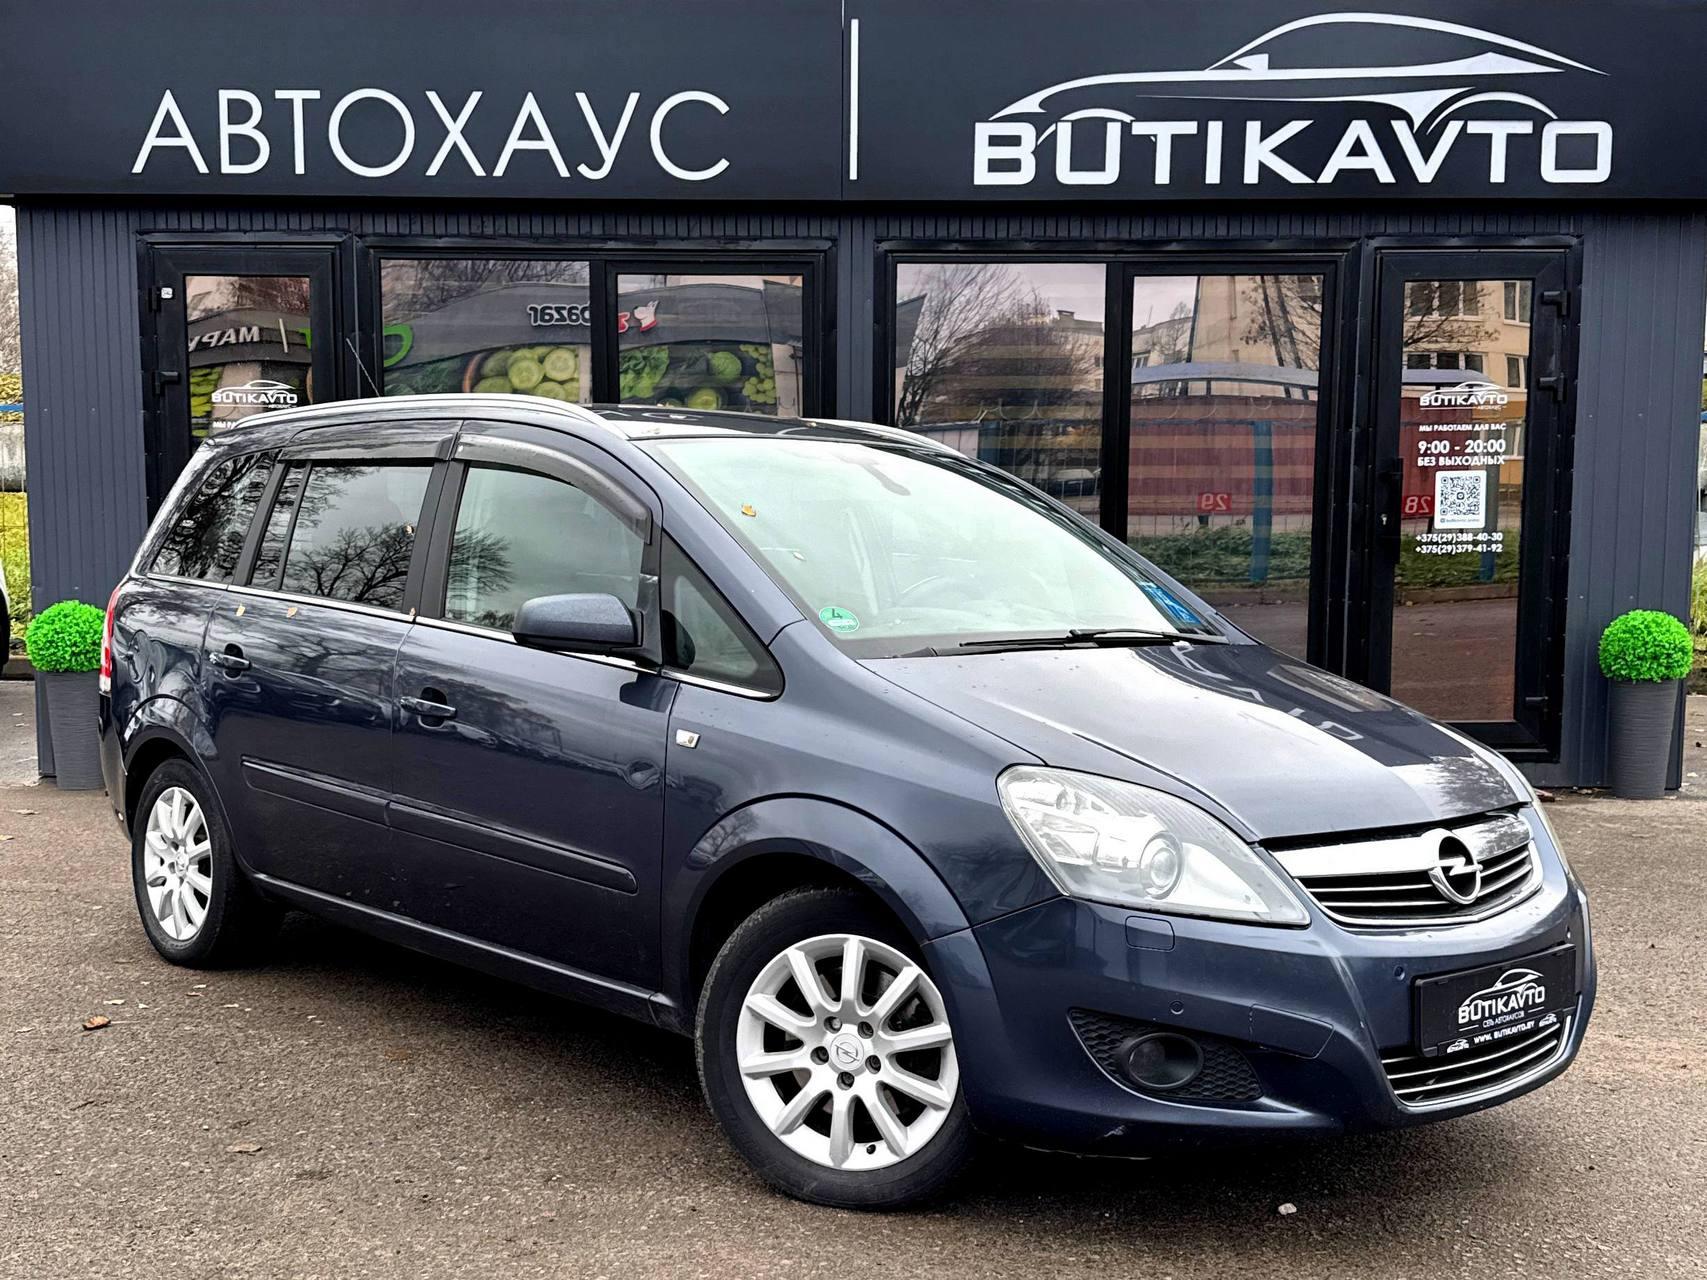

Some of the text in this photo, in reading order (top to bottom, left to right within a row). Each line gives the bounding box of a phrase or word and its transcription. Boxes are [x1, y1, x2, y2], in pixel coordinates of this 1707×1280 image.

[131, 88, 730, 180] АВТОХАУС
[974, 119, 1613, 186] BUTIKAVTO
[211, 392, 298, 404] BUTIKAVTO
[1419, 394, 1508, 406] BUTIKAVTO
[1433, 424, 1473, 432] РАБОТАЕМ
[1473, 423, 1490, 431] ДЛЯ
[1418, 440, 1450, 454] 9:00
[1464, 439, 1506, 453] 20:00
[1417, 455, 1505, 466] БЕЗ ВЫХОДНЫХ
[1415, 532, 1504, 543] +375(29)388-40-30
[1415, 543, 1504, 555] +375(29)379-41-92
[1458, 986, 1545, 1024] BUTIKAVTO
